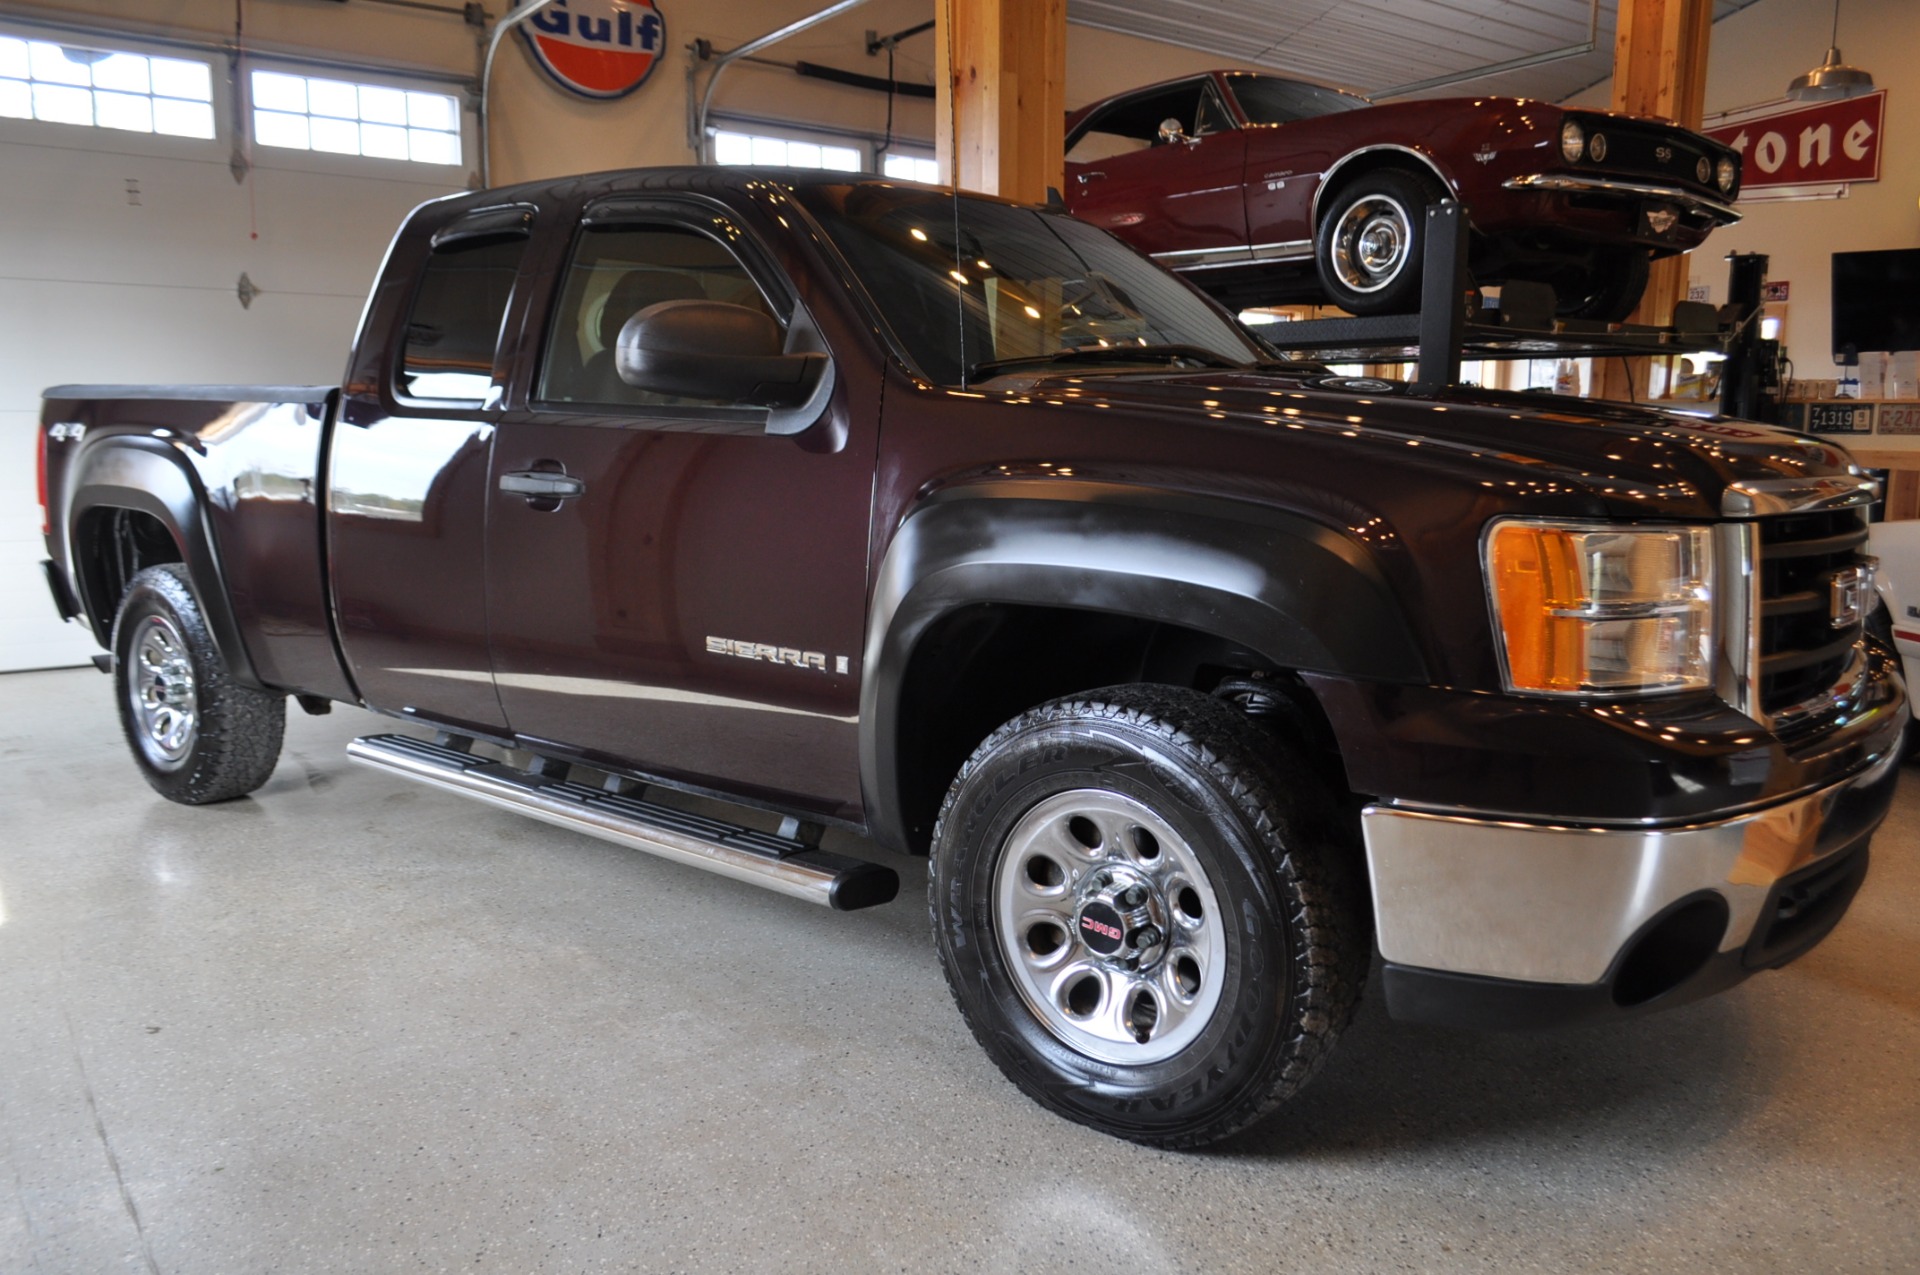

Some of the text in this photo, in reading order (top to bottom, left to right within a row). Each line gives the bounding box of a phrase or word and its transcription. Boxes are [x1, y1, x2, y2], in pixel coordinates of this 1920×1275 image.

[530, 0, 660, 50] Gulf
[1820, 411, 1853, 426] 1319
[706, 635, 826, 671] SIERRA
[1081, 915, 1122, 940] GMC
